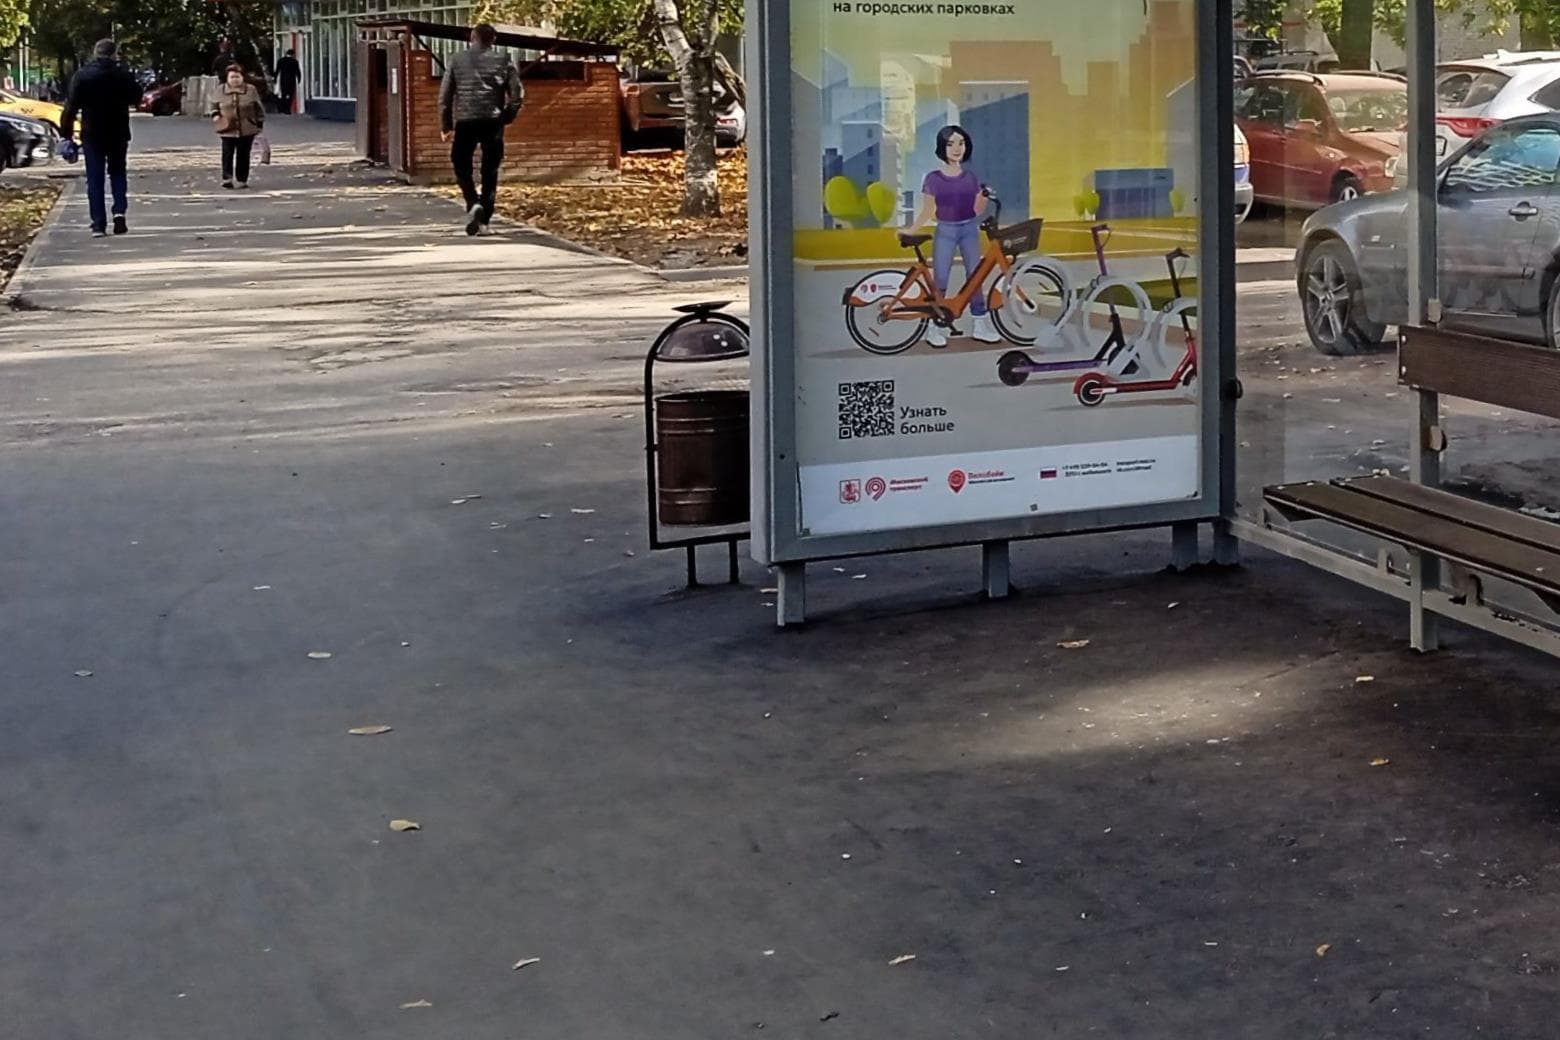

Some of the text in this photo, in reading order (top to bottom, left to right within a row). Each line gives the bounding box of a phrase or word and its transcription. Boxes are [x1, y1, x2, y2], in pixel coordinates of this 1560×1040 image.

[833, 1, 1015, 18] на городских парковках
[900, 406, 947, 419] Узнать
[900, 421, 955, 435] больше
